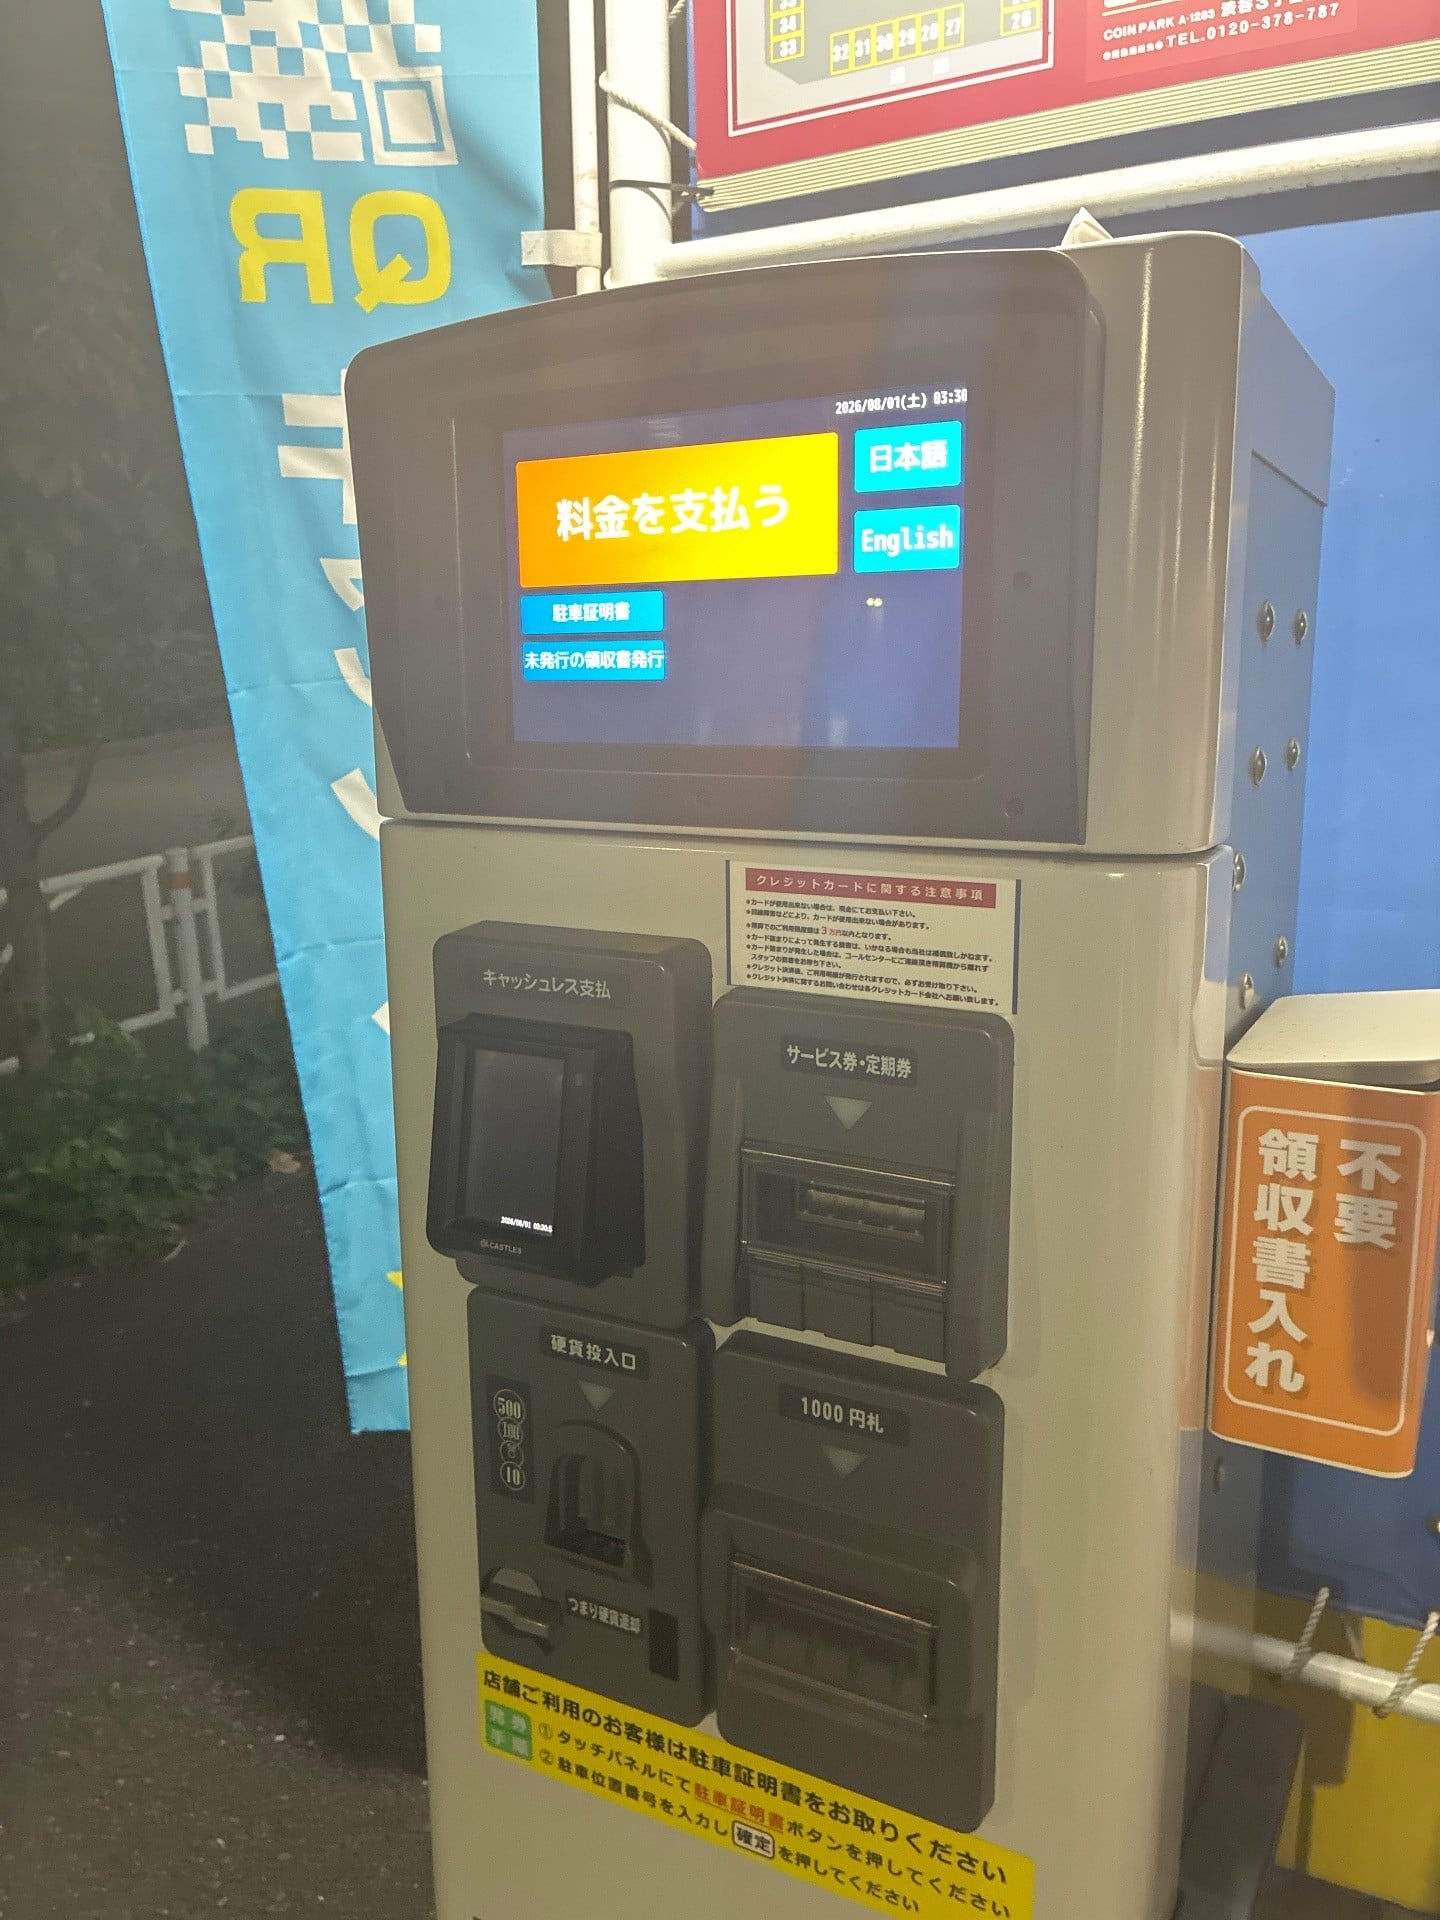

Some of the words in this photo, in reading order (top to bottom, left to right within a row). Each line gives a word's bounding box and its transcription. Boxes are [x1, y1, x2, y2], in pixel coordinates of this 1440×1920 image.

[1139, 17, 1175, 34] PARK
[933, 388, 968, 405] 03:30
[869, 440, 948, 473] 日本語
[556, 485, 790, 541] 料金を支払う
[861, 525, 954, 557] English
[552, 602, 630, 622] 駐車証明書
[524, 650, 664, 671] 未発行の領収書発行
[756, 875, 984, 901] クレジットカードに関する注意事項
[483, 969, 611, 999] キャッシュレス支払
[786, 1044, 911, 1079] サービス券・定期券
[1334, 1139, 1401, 1250] 不要
[1245, 1128, 1320, 1393] 領収書入れ
[551, 1334, 636, 1371] 硬貨投入口
[497, 1397, 521, 1419] 500
[801, 1397, 843, 1424] 1000
[849, 1406, 884, 1434] 円札
[507, 1466, 520, 1485] 10
[484, 1670, 1006, 1883] 店舗ご利用のお客様は駐車証明書をお取りください
